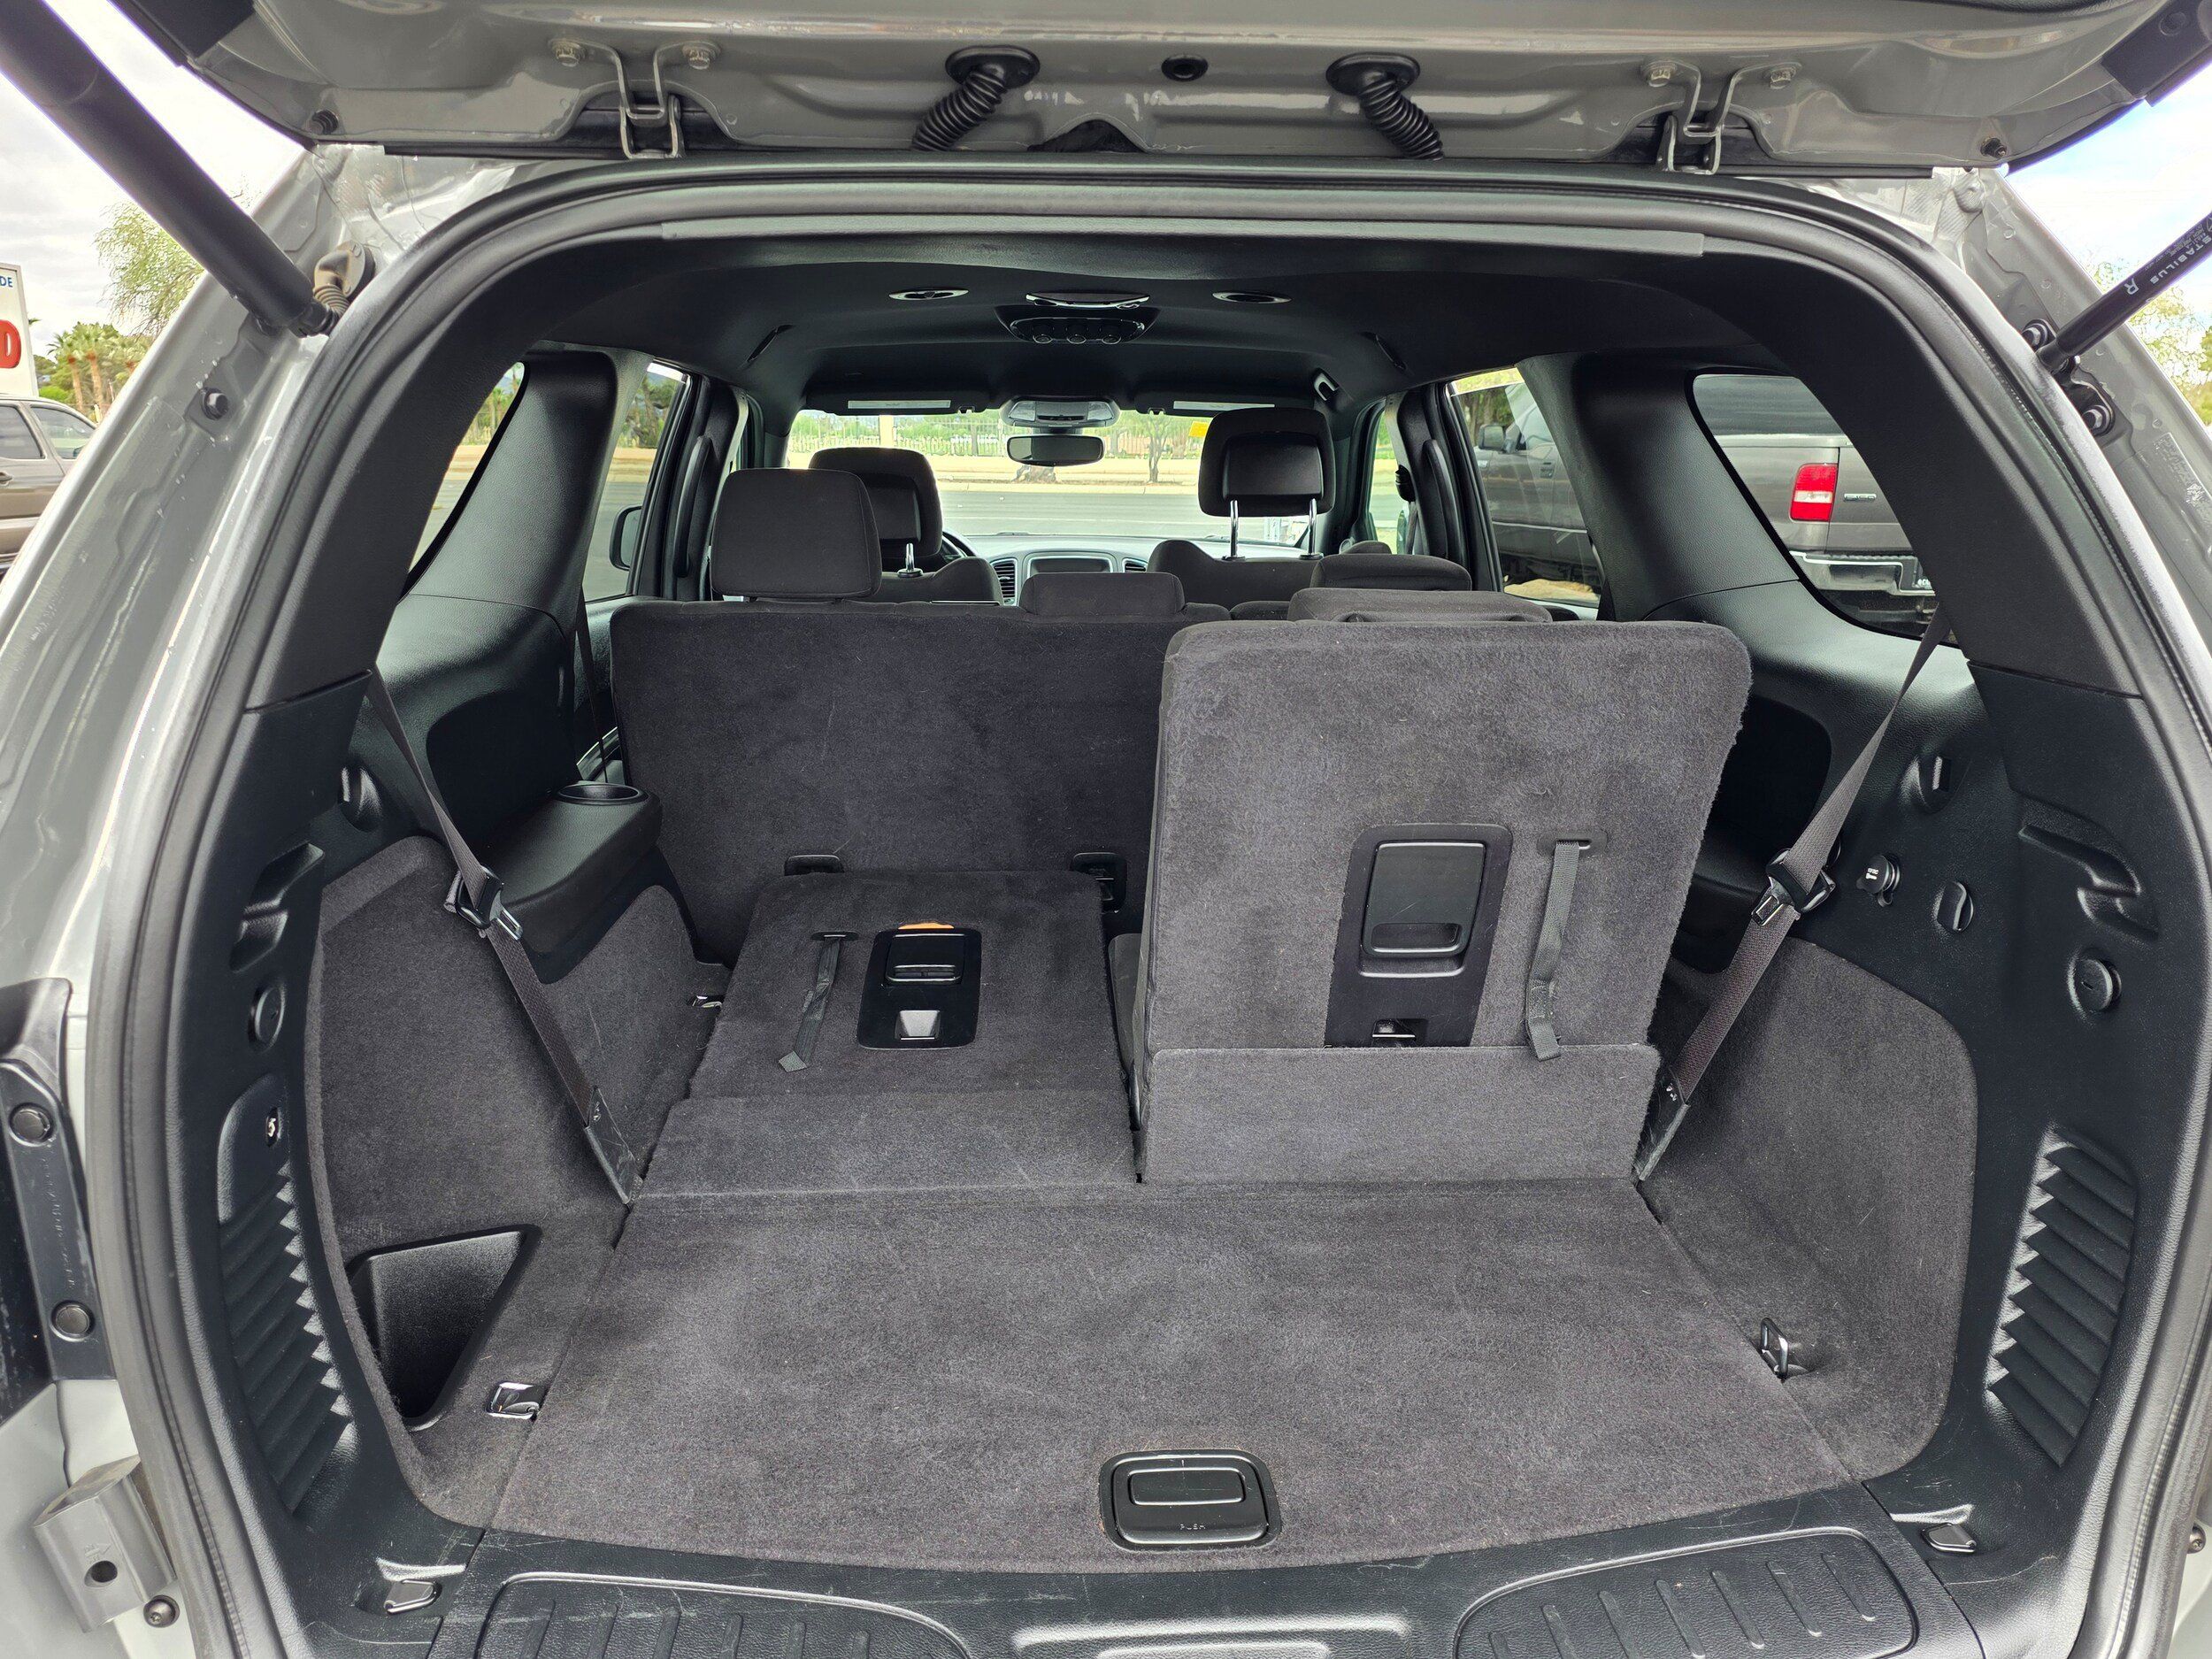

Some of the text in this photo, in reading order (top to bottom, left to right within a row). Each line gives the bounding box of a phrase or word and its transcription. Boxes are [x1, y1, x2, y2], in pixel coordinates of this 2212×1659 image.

[2149, 234, 2212, 284] STABILUS
[0, 275, 13, 288] DE
[2124, 278, 2140, 296] R
